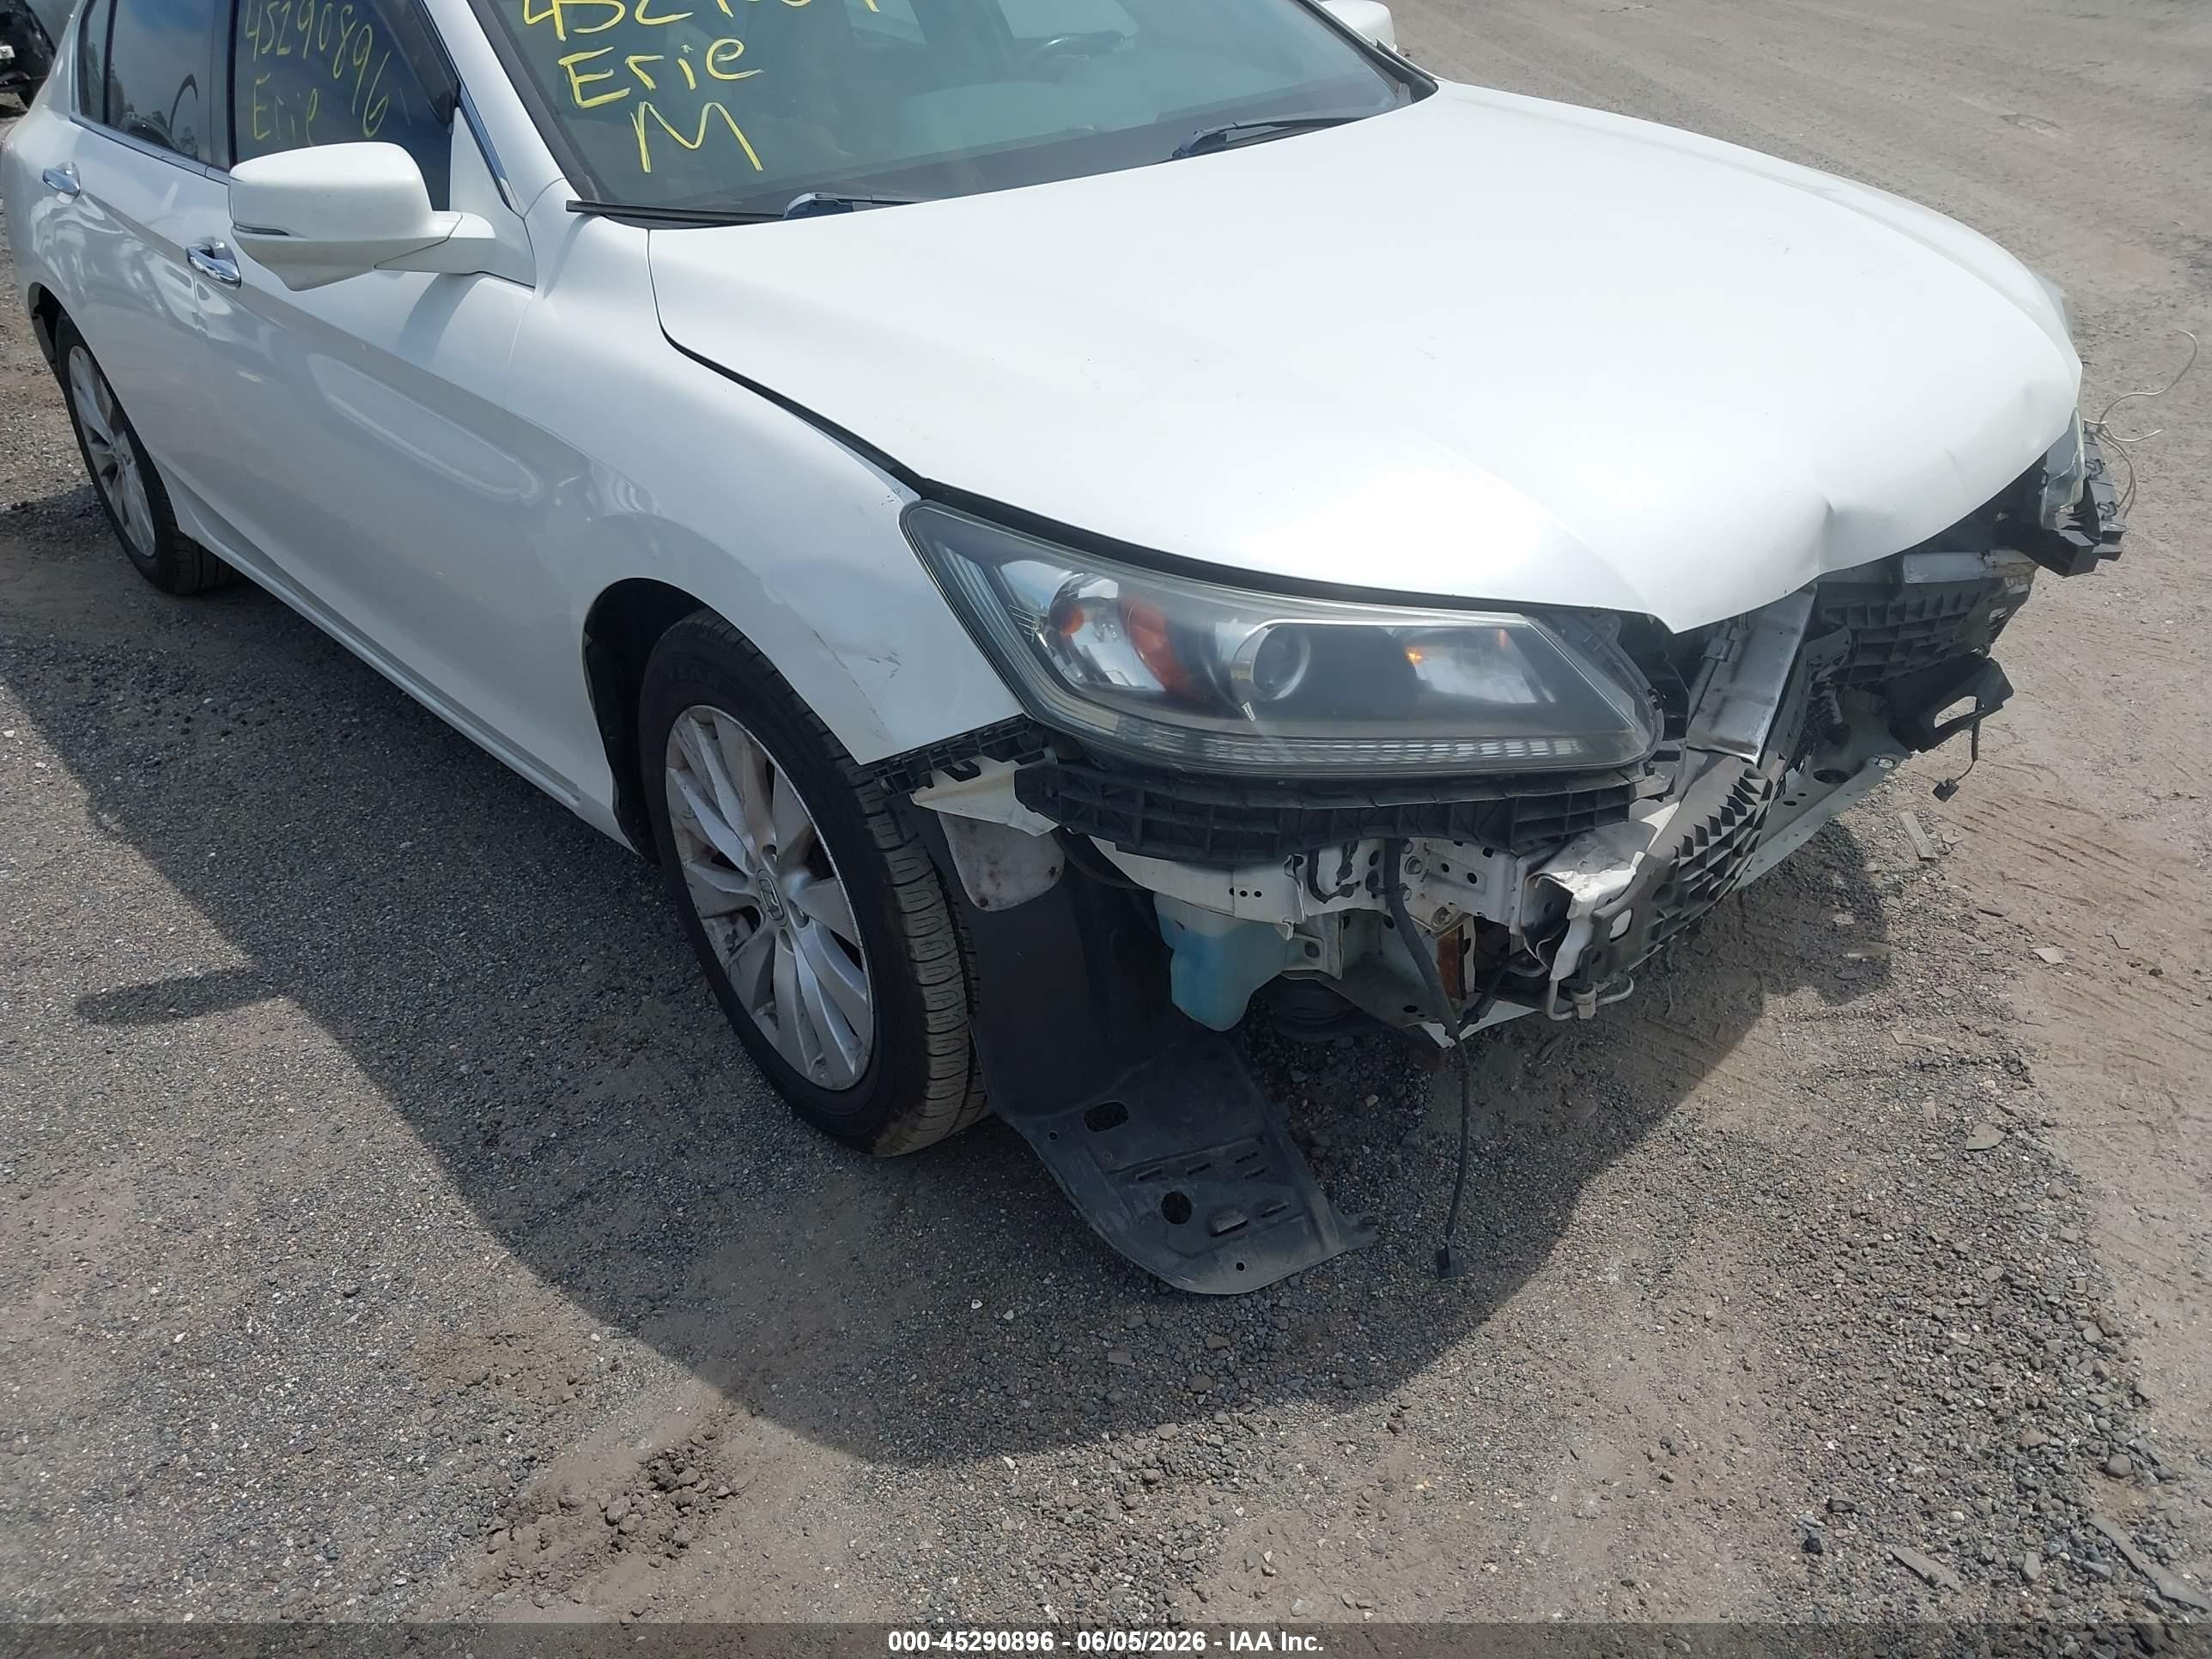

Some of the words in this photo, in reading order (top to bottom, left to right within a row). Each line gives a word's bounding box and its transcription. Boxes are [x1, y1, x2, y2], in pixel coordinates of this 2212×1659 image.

[246, 0, 392, 138] 45290896
[558, 38, 763, 108] Erie
[629, 101, 763, 173] M
